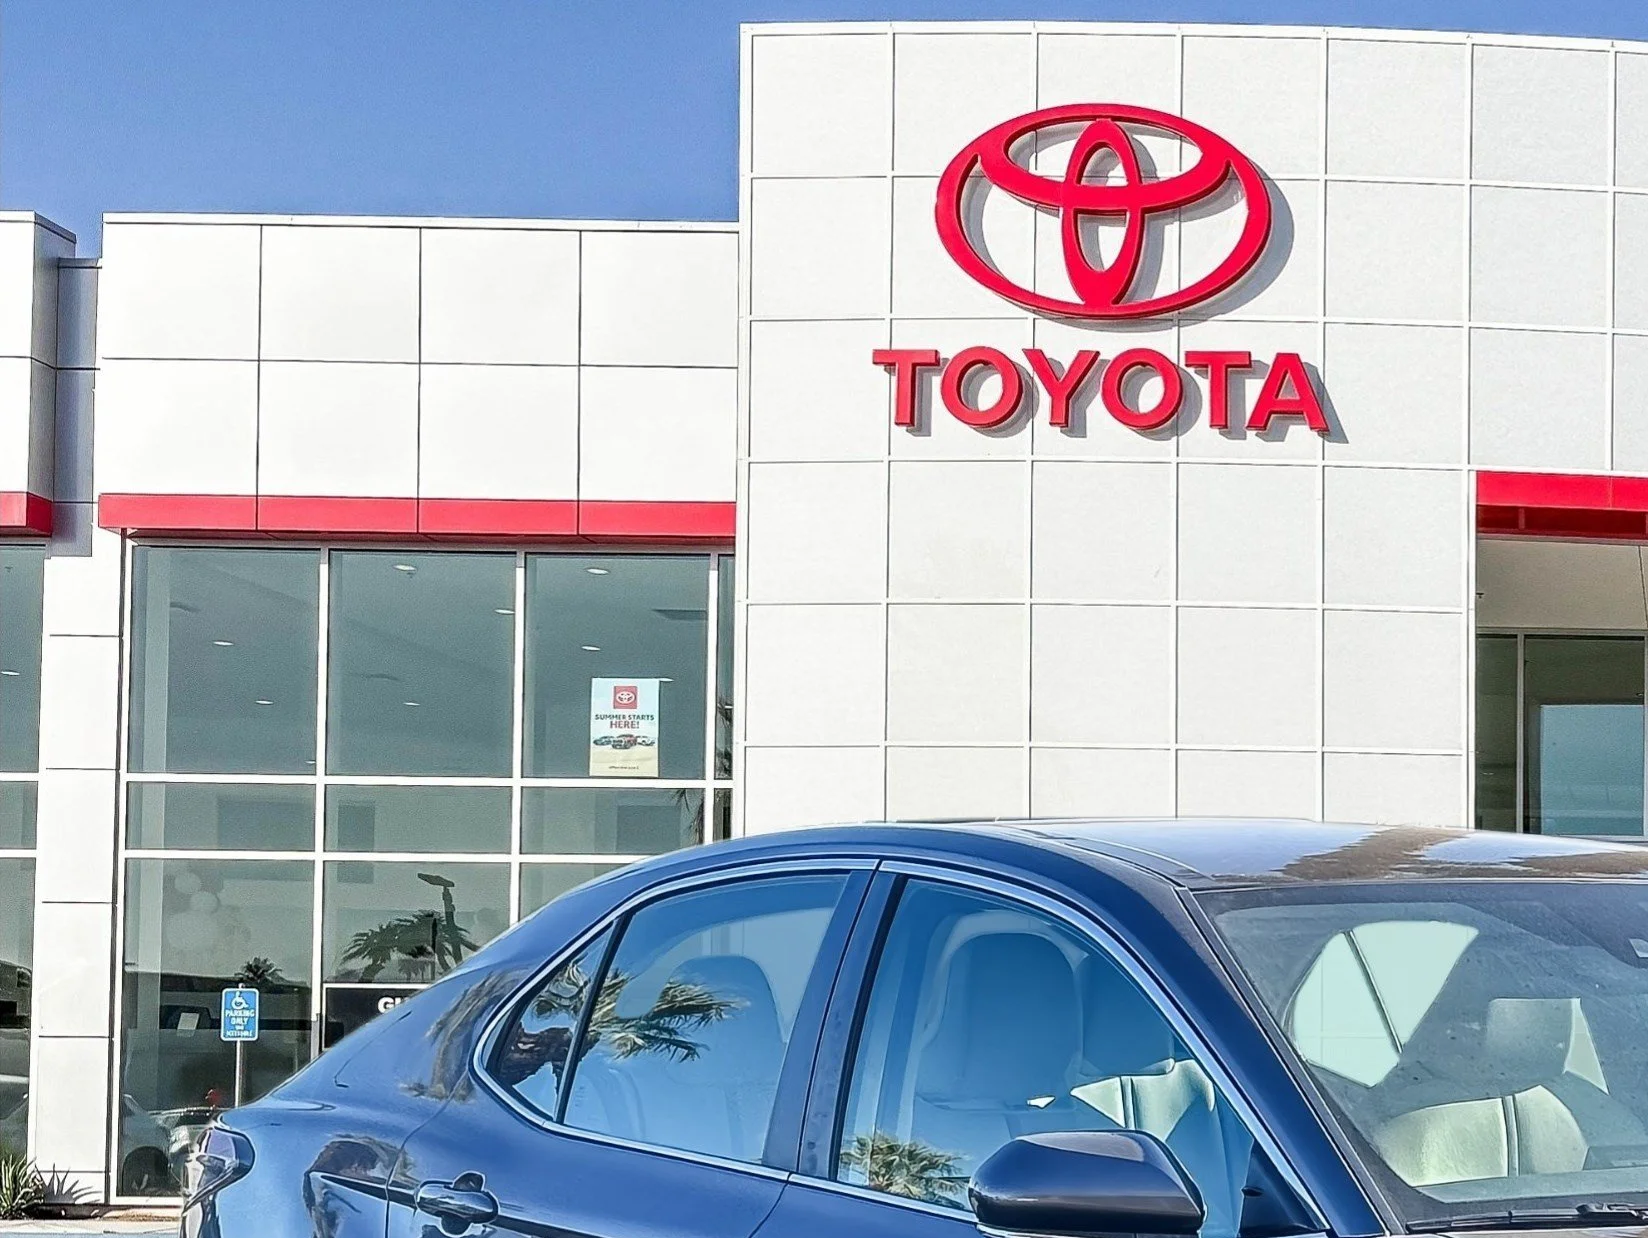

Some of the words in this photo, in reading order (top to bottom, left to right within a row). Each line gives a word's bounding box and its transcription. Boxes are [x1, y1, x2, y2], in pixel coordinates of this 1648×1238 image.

[872, 345, 1330, 433] TOYOTA
[594, 713, 626, 721] SUMMER
[628, 713, 655, 721] STARTS
[609, 720, 640, 729] HERE!
